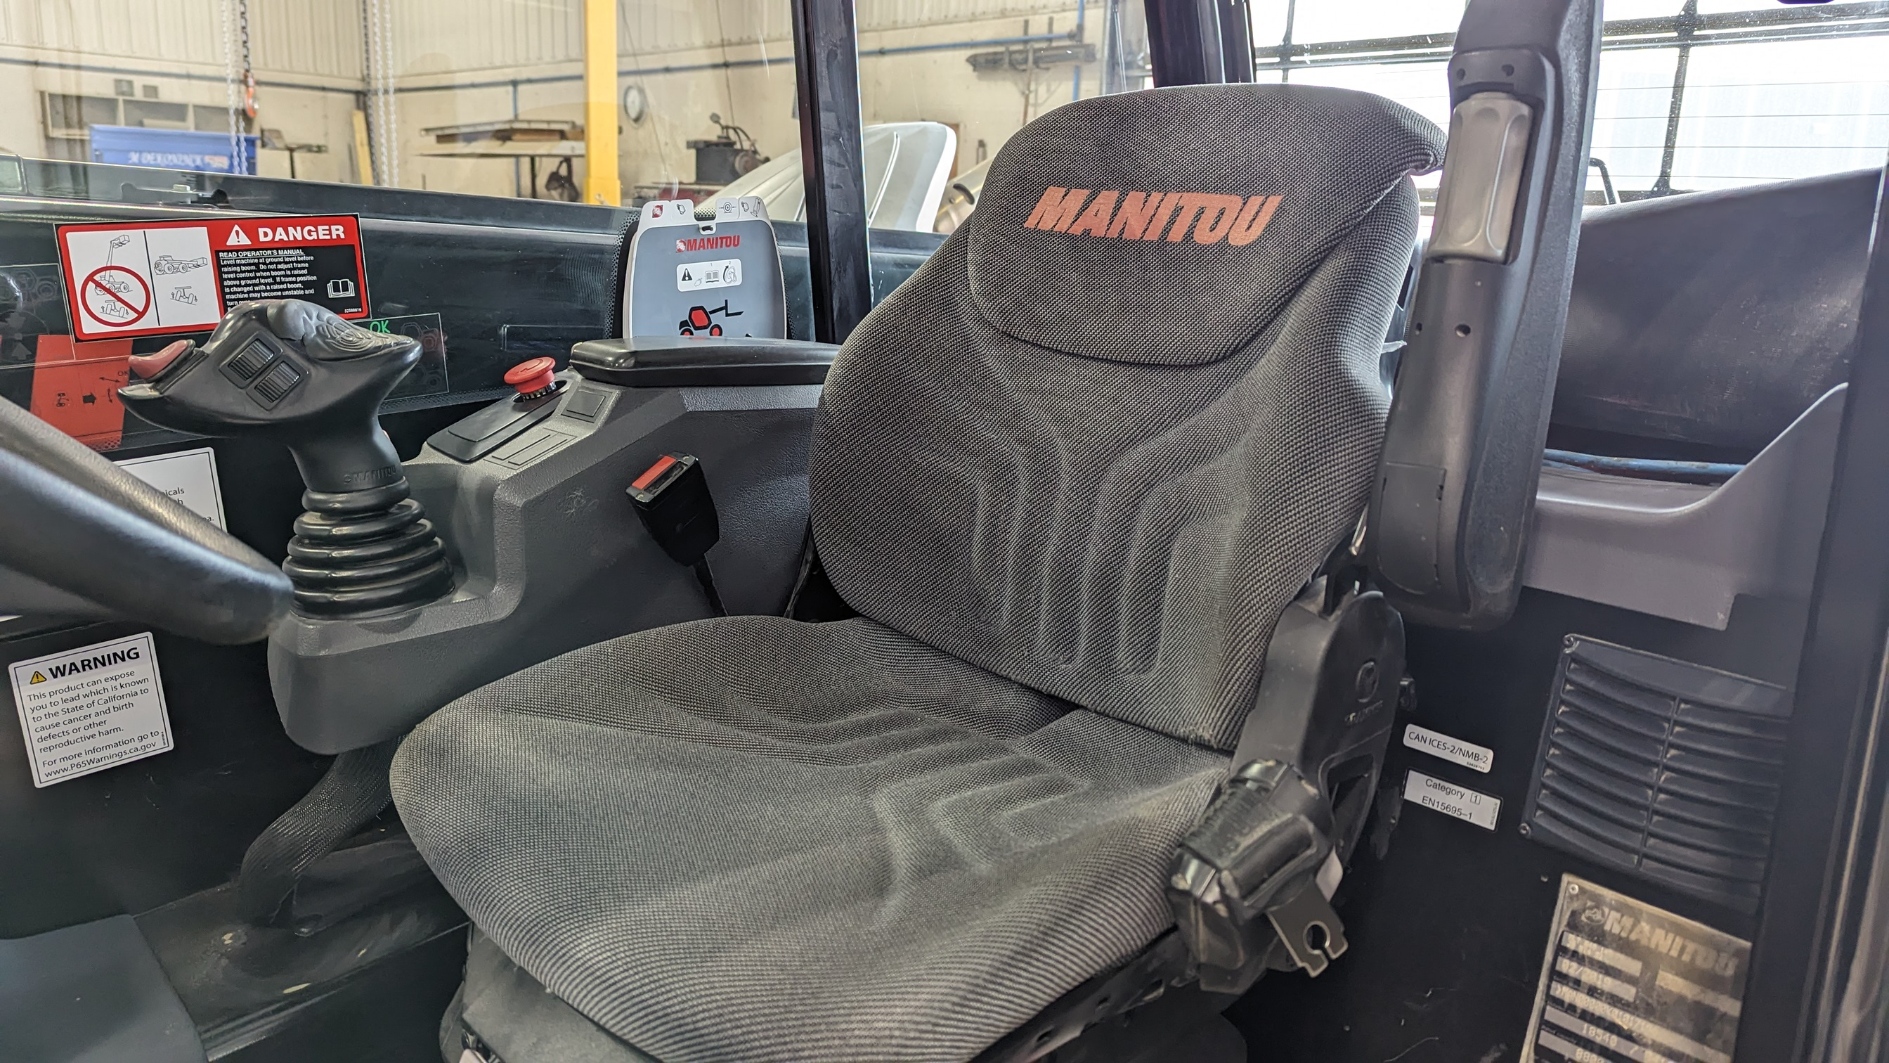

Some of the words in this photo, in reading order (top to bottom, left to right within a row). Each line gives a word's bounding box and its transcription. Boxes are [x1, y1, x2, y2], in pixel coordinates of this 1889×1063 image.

[1024, 186, 1284, 246] MANITOU
[258, 225, 345, 242] DANGER
[686, 235, 740, 251] MANITOU
[370, 320, 390, 333] OK
[48, 647, 140, 679] WARNING
[27, 692, 46, 701] This
[49, 682, 84, 698] product
[86, 679, 102, 687] can
[104, 671, 135, 682] expose
[30, 704, 48, 714] you
[61, 693, 80, 704] lead
[82, 687, 109, 699] which
[120, 677, 149, 689] known
[35, 722, 60, 733] cause
[63, 713, 92, 726] cancer
[94, 707, 111, 718] and
[113, 701, 134, 712] birth
[44, 711, 59, 720] the
[61, 704, 84, 715] State
[86, 699, 95, 708] of
[97, 690, 138, 706] California
[37, 730, 70, 743] defects
[84, 720, 107, 730] other
[40, 733, 96, 753] reproductive
[98, 726, 124, 737] harm.
[43, 759, 57, 768] For
[59, 752, 82, 763] more
[85, 738, 135, 756] information
[137, 734, 148, 742] go
[44, 742, 156, 778] www.P65Warnings.ca.gov
[1408, 731, 1428, 744] CAN
[1428, 737, 1488, 764] ICES-2/NMB-2
[1425, 778, 1465, 800] Category
[1422, 795, 1473, 820] EN15695-1
[1604, 910, 1738, 977] MANITOU
[1582, 1023, 1618, 1047] 18540
